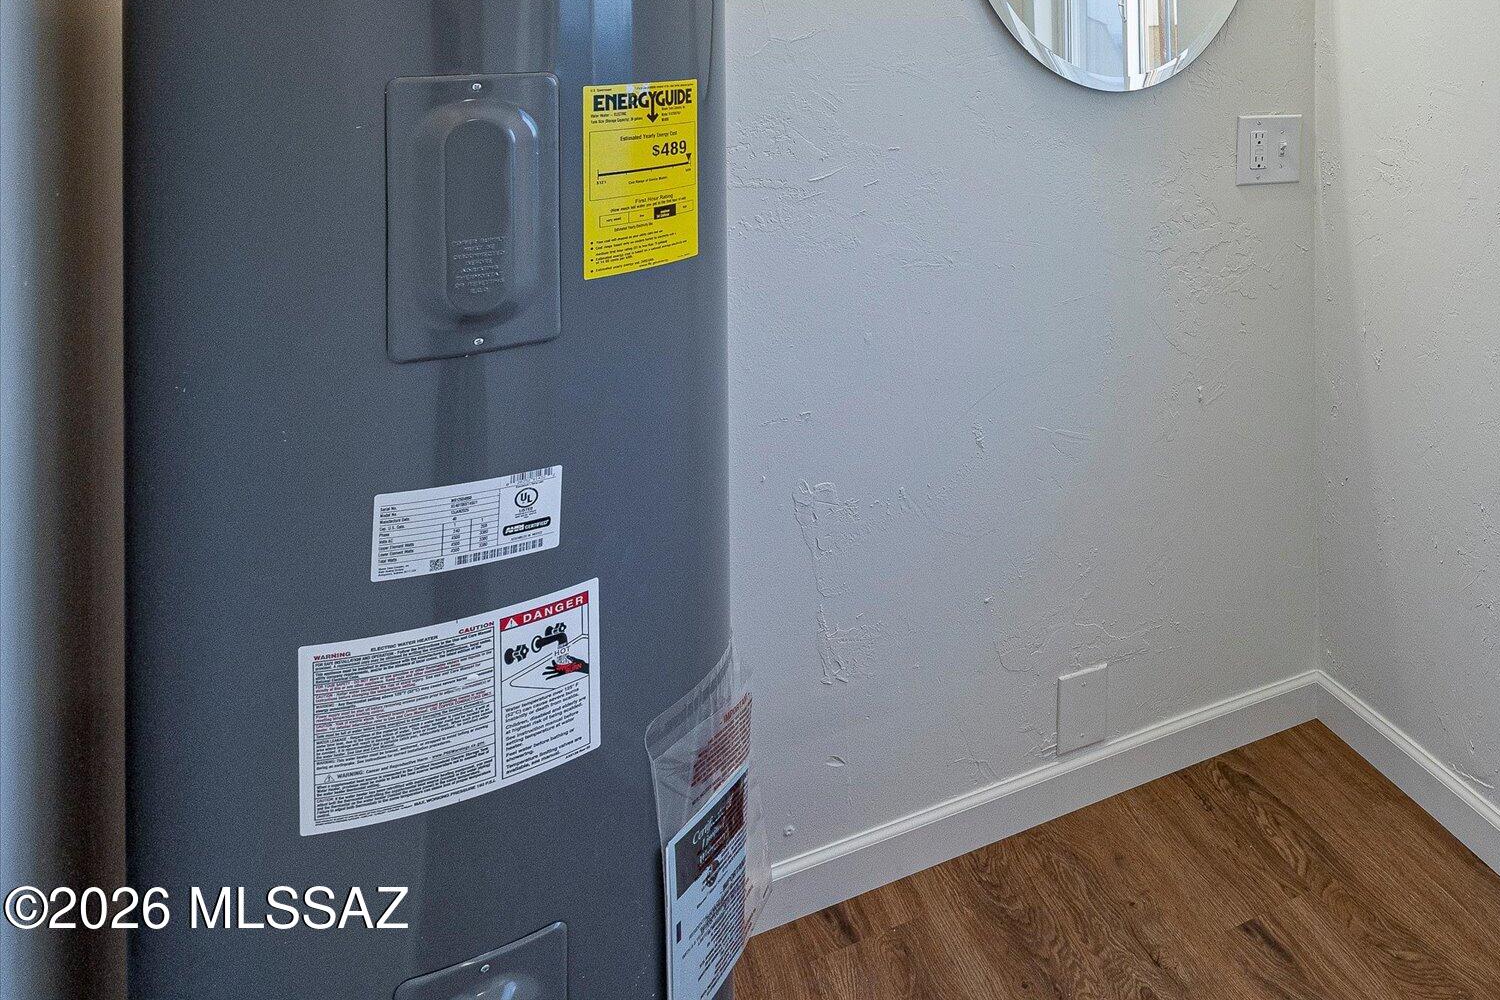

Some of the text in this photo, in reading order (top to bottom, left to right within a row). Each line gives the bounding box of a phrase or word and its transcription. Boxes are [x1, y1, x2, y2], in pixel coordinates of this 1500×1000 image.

[593, 88, 692, 112] ENERGYGUIDE
[652, 140, 686, 156] $489
[520, 492, 533, 503] UL
[523, 596, 583, 623] DANGER
[458, 621, 495, 635] CAUTION
[370, 635, 439, 652] ELECTRIC WATER HEATER
[554, 646, 571, 656] HOT
[313, 652, 351, 661] WARNING
